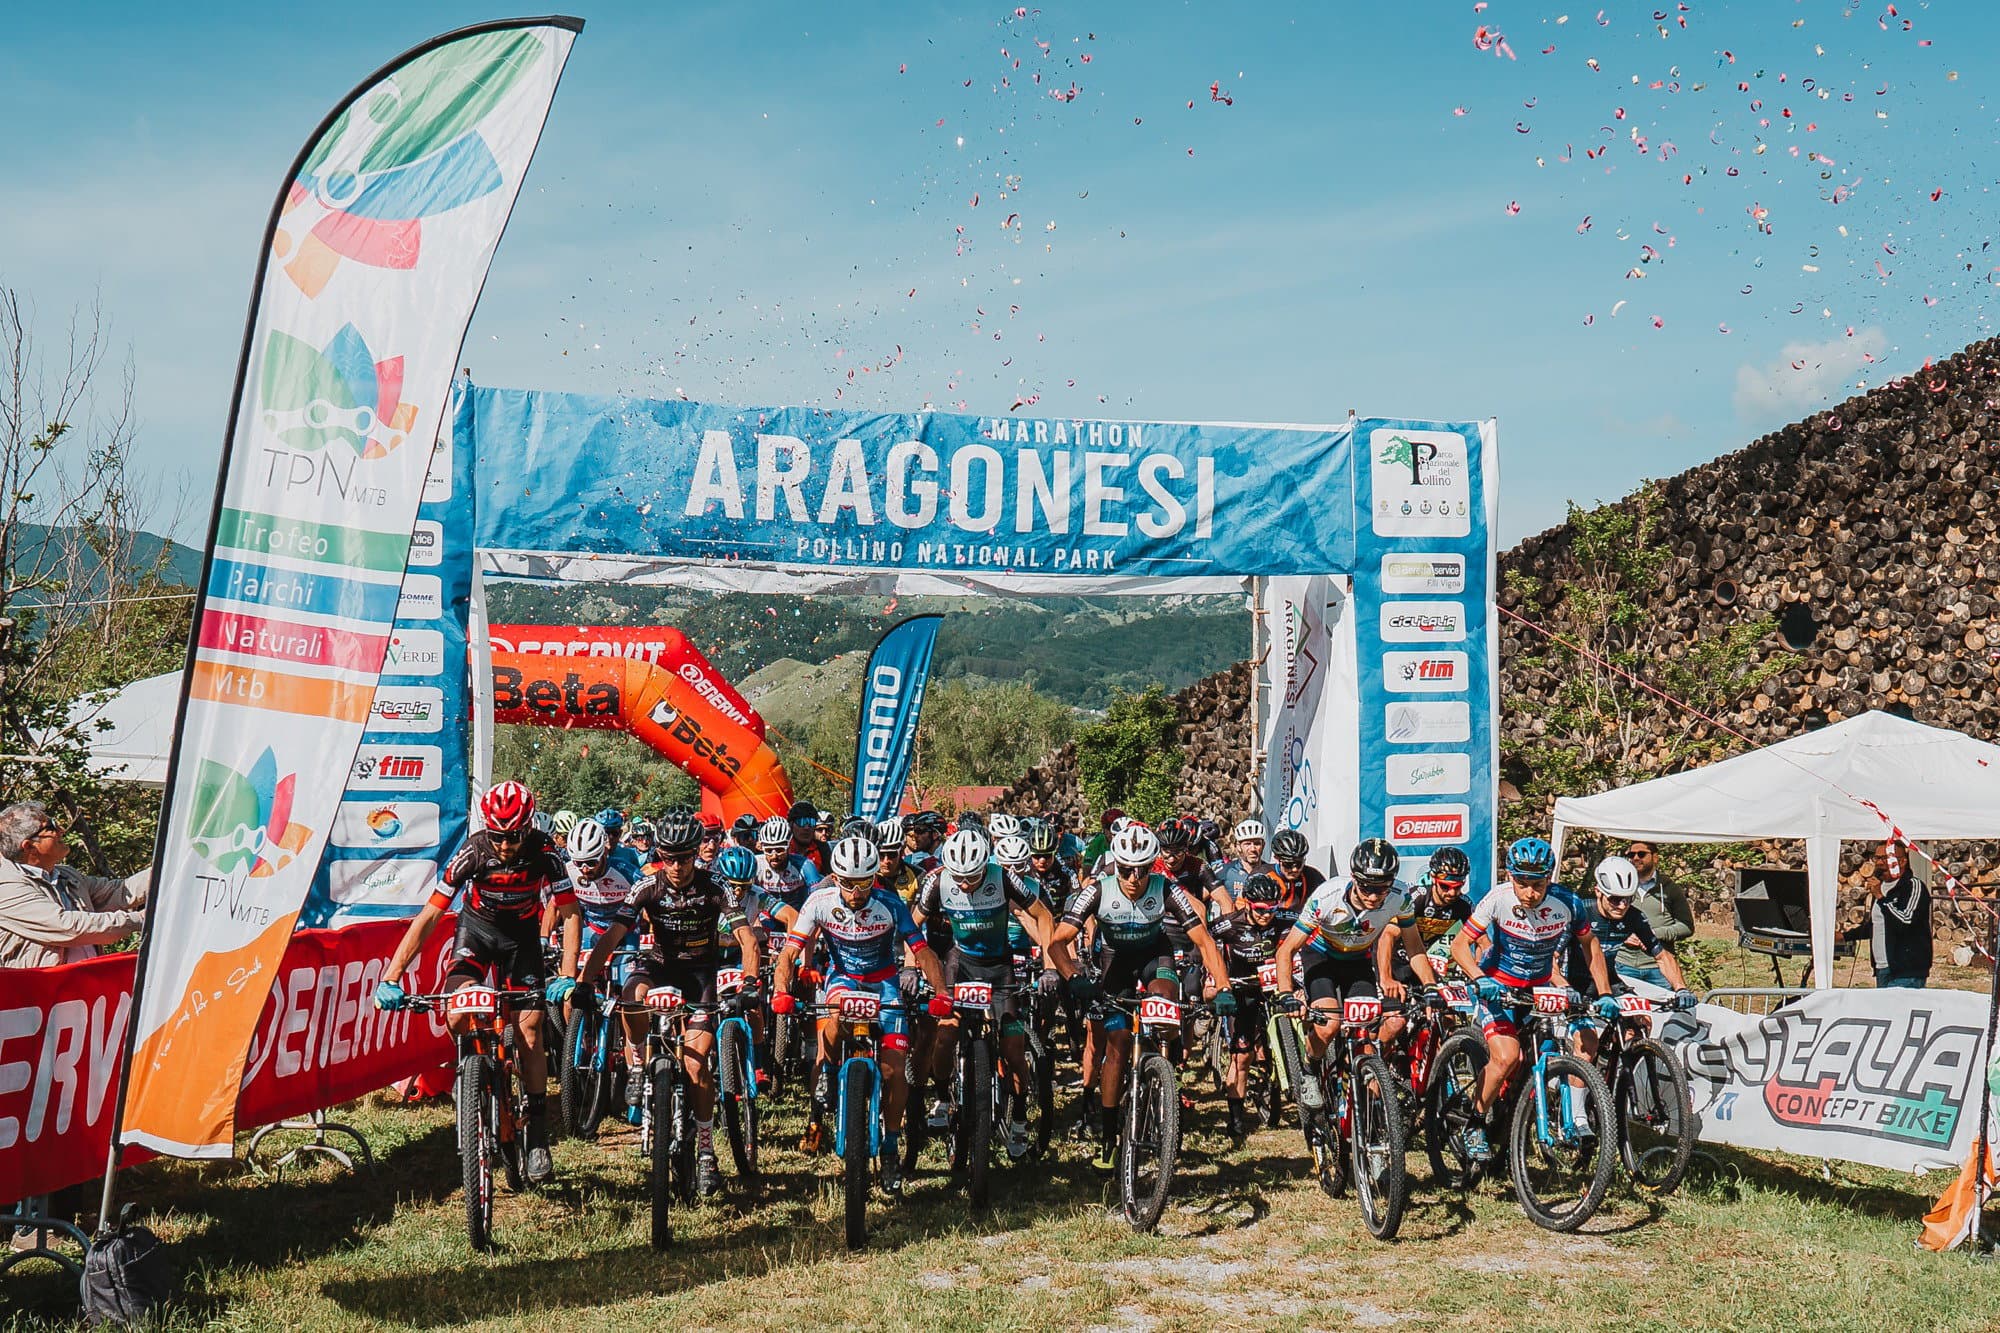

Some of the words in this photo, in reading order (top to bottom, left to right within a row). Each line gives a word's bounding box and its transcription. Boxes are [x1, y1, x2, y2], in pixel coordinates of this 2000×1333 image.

[992, 419, 1142, 448] MARATHON
[264, 448, 357, 501] TPN
[351, 487, 387, 506] MTB
[684, 429, 1215, 540] ARAGONESI
[241, 518, 329, 557] Trofeo
[412, 533, 433, 545] vice
[411, 549, 433, 559] igna
[797, 537, 902, 562] POLLINO
[919, 542, 1043, 568] NATIONAL
[1054, 546, 1117, 570] PARK
[1434, 565, 1460, 576] service
[1440, 579, 1461, 589] Vigna
[224, 620, 324, 660] Naturali
[1285, 599, 1296, 709] ARAGONESI
[1419, 660, 1454, 677] fim
[493, 665, 621, 717] Beta
[697, 678, 751, 727] ENERVIT
[670, 713, 741, 779] Beta
[380, 756, 424, 777] fim
[1414, 820, 1459, 834] ENERVIT
[237, 903, 270, 926] MTB
[826, 922, 848, 932] BIKE
[855, 922, 888, 933] SPORT
[1505, 920, 1529, 930] BIKE
[1536, 921, 1566, 934] SPORT
[717, 971, 741, 987] 012
[1263, 970, 1278, 984] 01
[455, 991, 491, 1007] 010
[959, 987, 989, 1004] 006
[1623, 997, 1647, 1010] 017
[843, 998, 877, 1017] 009
[1146, 1001, 1178, 1018] 004
[1348, 1003, 1379, 1021] 001
[0, 991, 132, 1150] ERV
[1775, 1092, 1877, 1121] CONCEPT
[1876, 1100, 1953, 1136] BIKE
